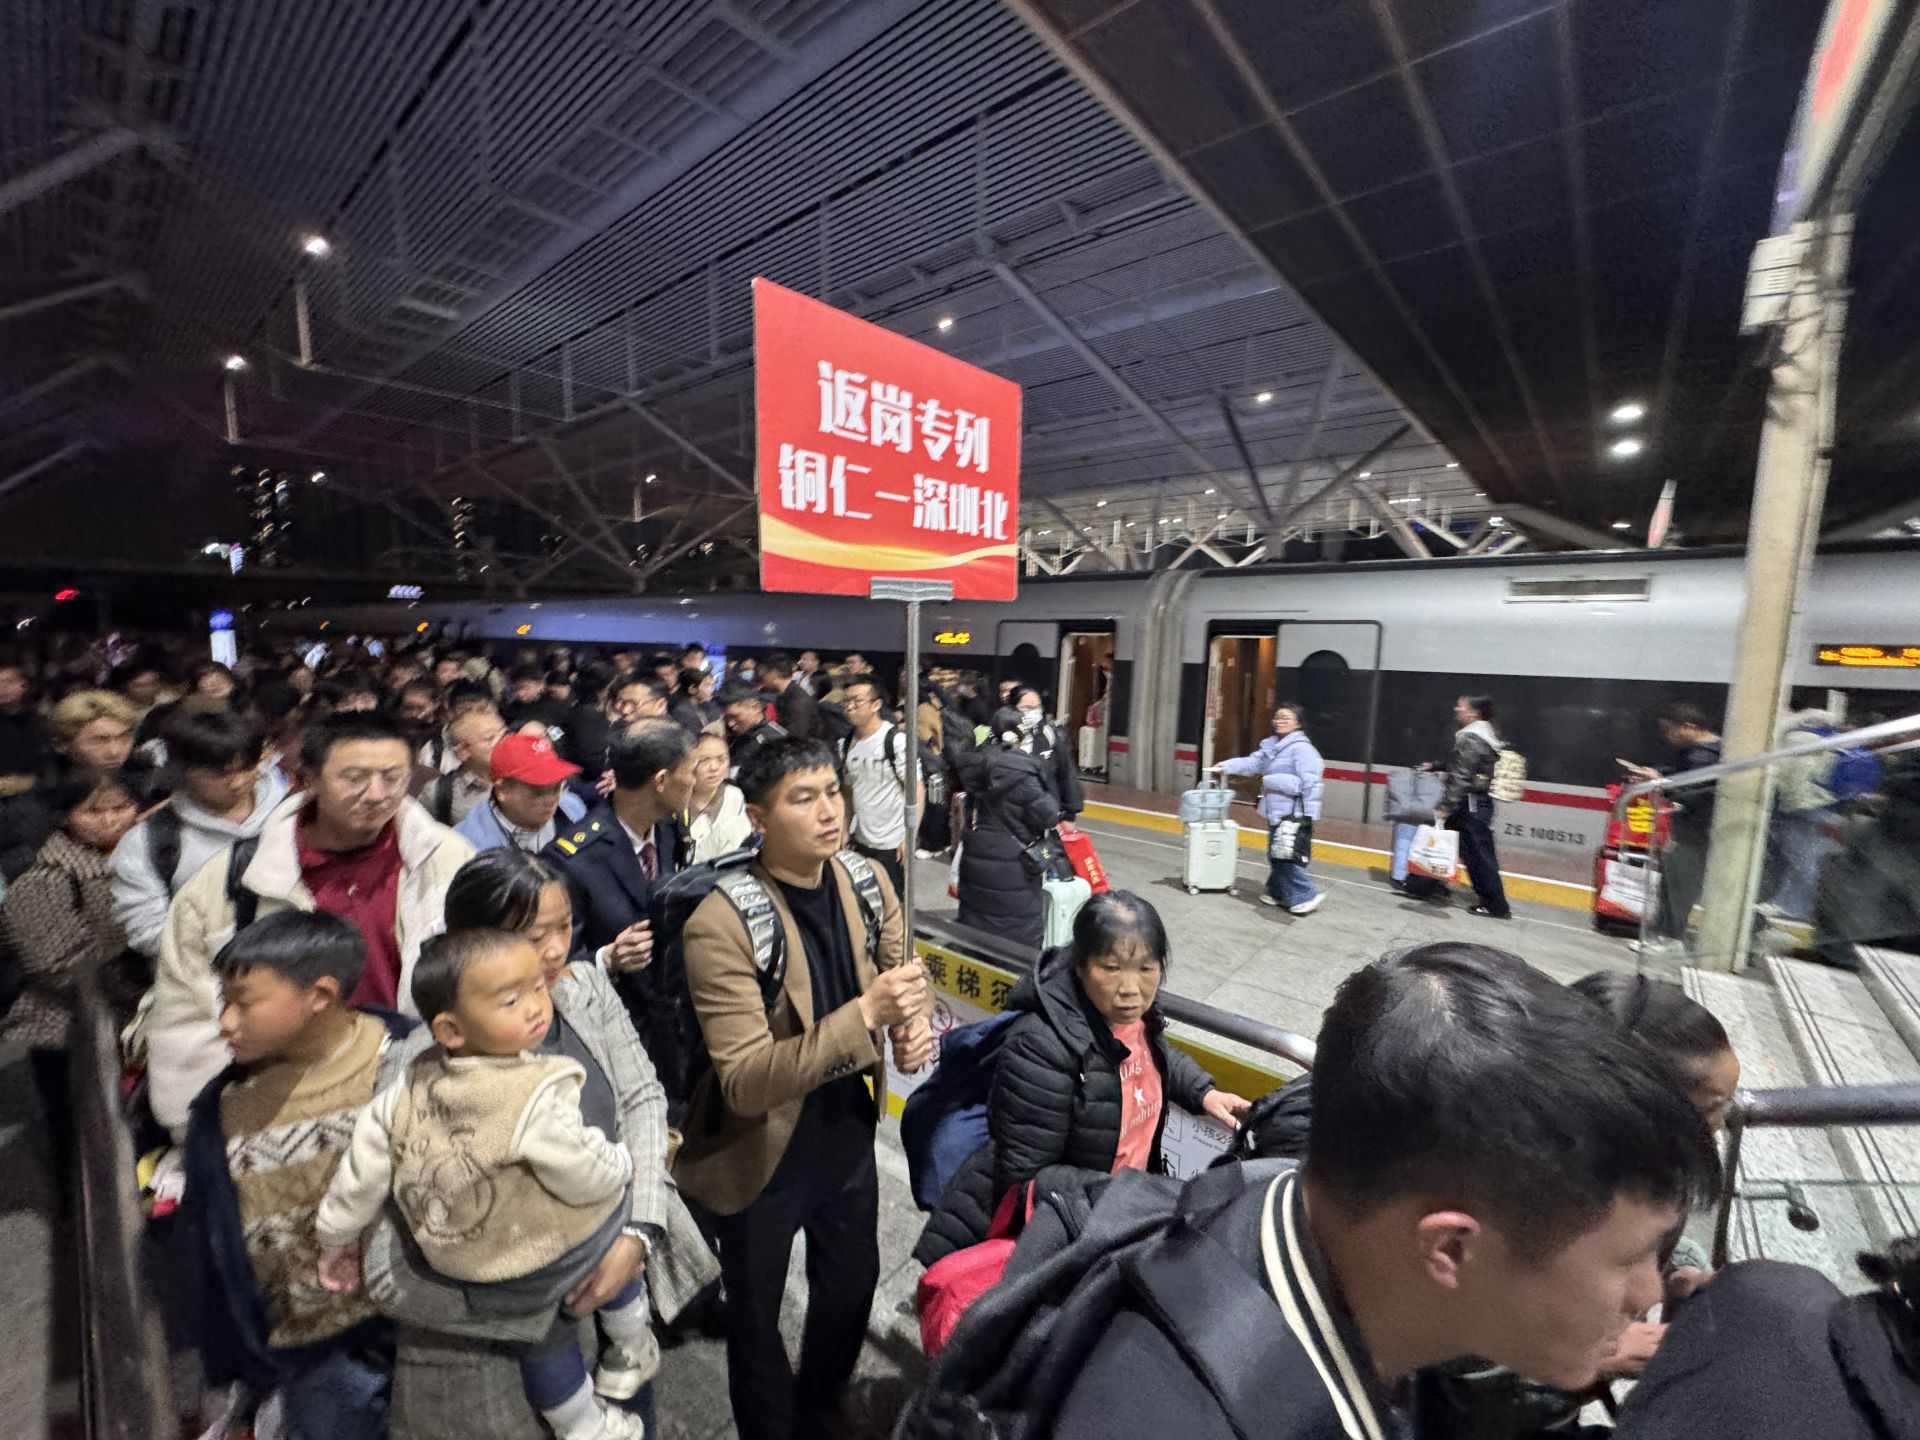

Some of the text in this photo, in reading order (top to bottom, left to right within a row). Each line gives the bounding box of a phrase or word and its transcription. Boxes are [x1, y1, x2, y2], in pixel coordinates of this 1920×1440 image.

[817, 359, 990, 473] 返岗专列
[1503, 822, 1525, 837] ZE
